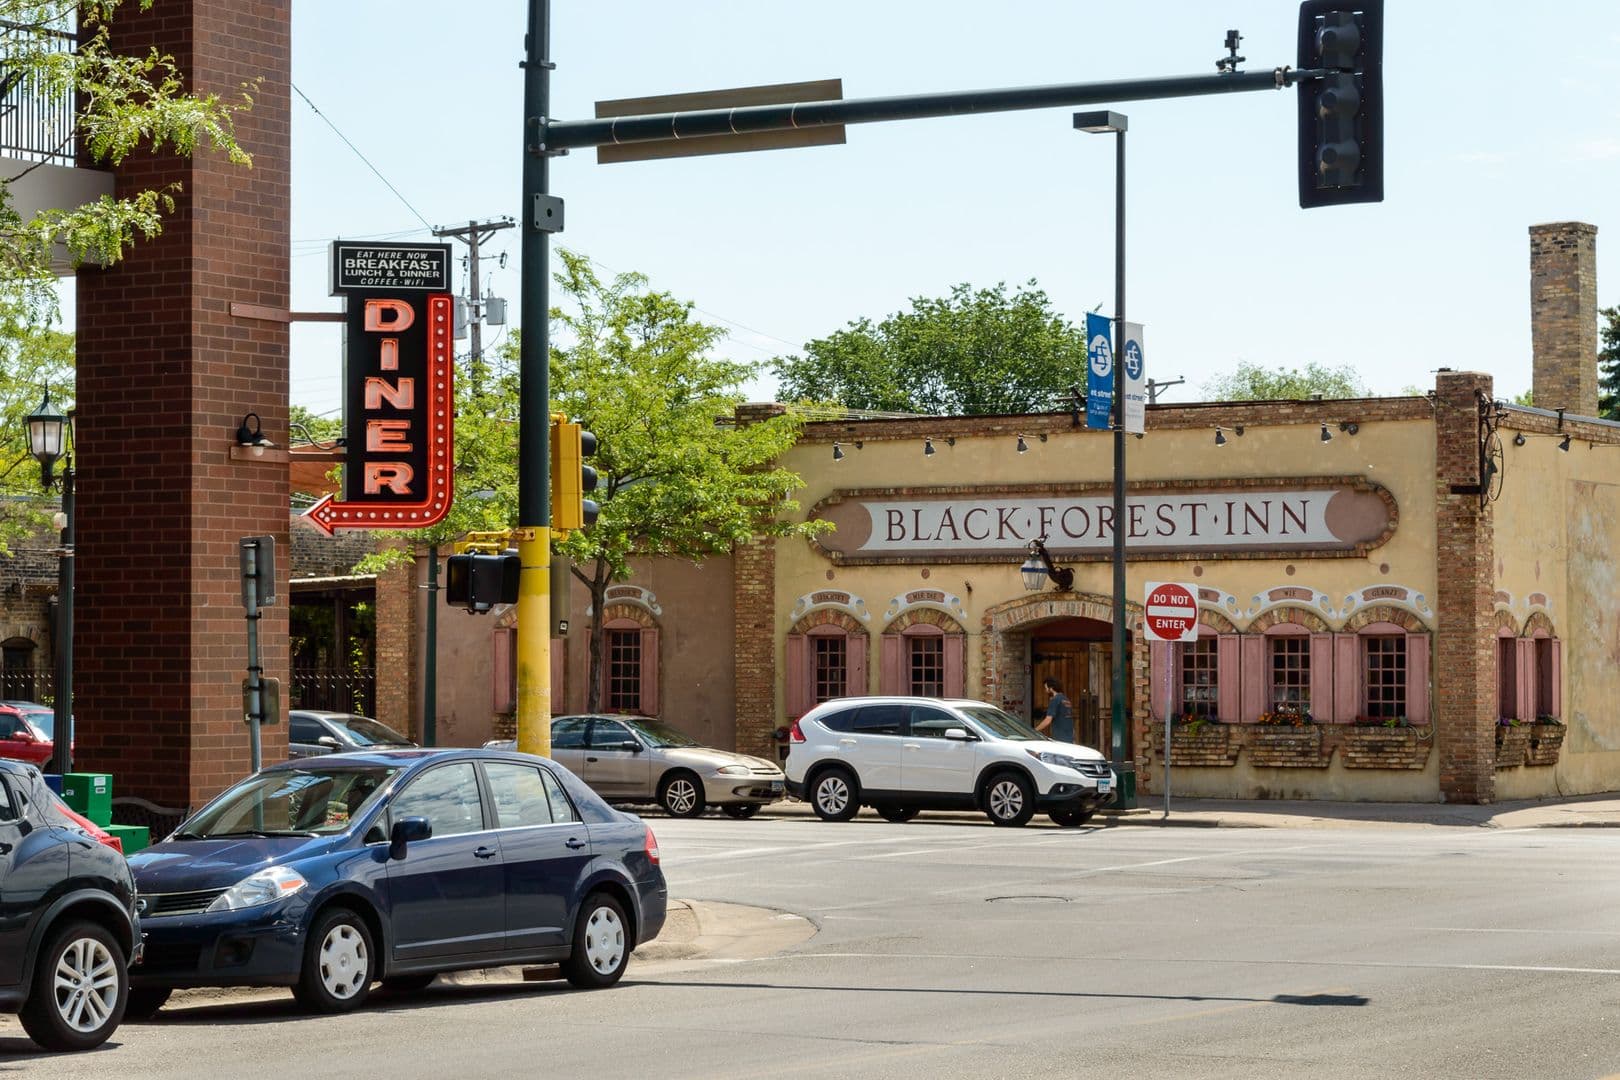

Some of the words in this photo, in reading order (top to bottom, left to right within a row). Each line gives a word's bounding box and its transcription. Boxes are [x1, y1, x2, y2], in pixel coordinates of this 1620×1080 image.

[377, 251, 403, 259] HERE
[406, 252, 428, 260] NOW
[345, 258, 440, 270] BREAKFAST
[345, 269, 382, 277] LUNCH
[399, 270, 440, 278] DINNER
[364, 298, 415, 495] DINER
[885, 505, 1025, 541] BLACK
[1037, 503, 1208, 539] FOREST
[1224, 500, 1310, 535] INN
[1153, 594, 1167, 604] DO
[1170, 595, 1189, 605] NOT
[1156, 619, 1186, 629] ENTER
